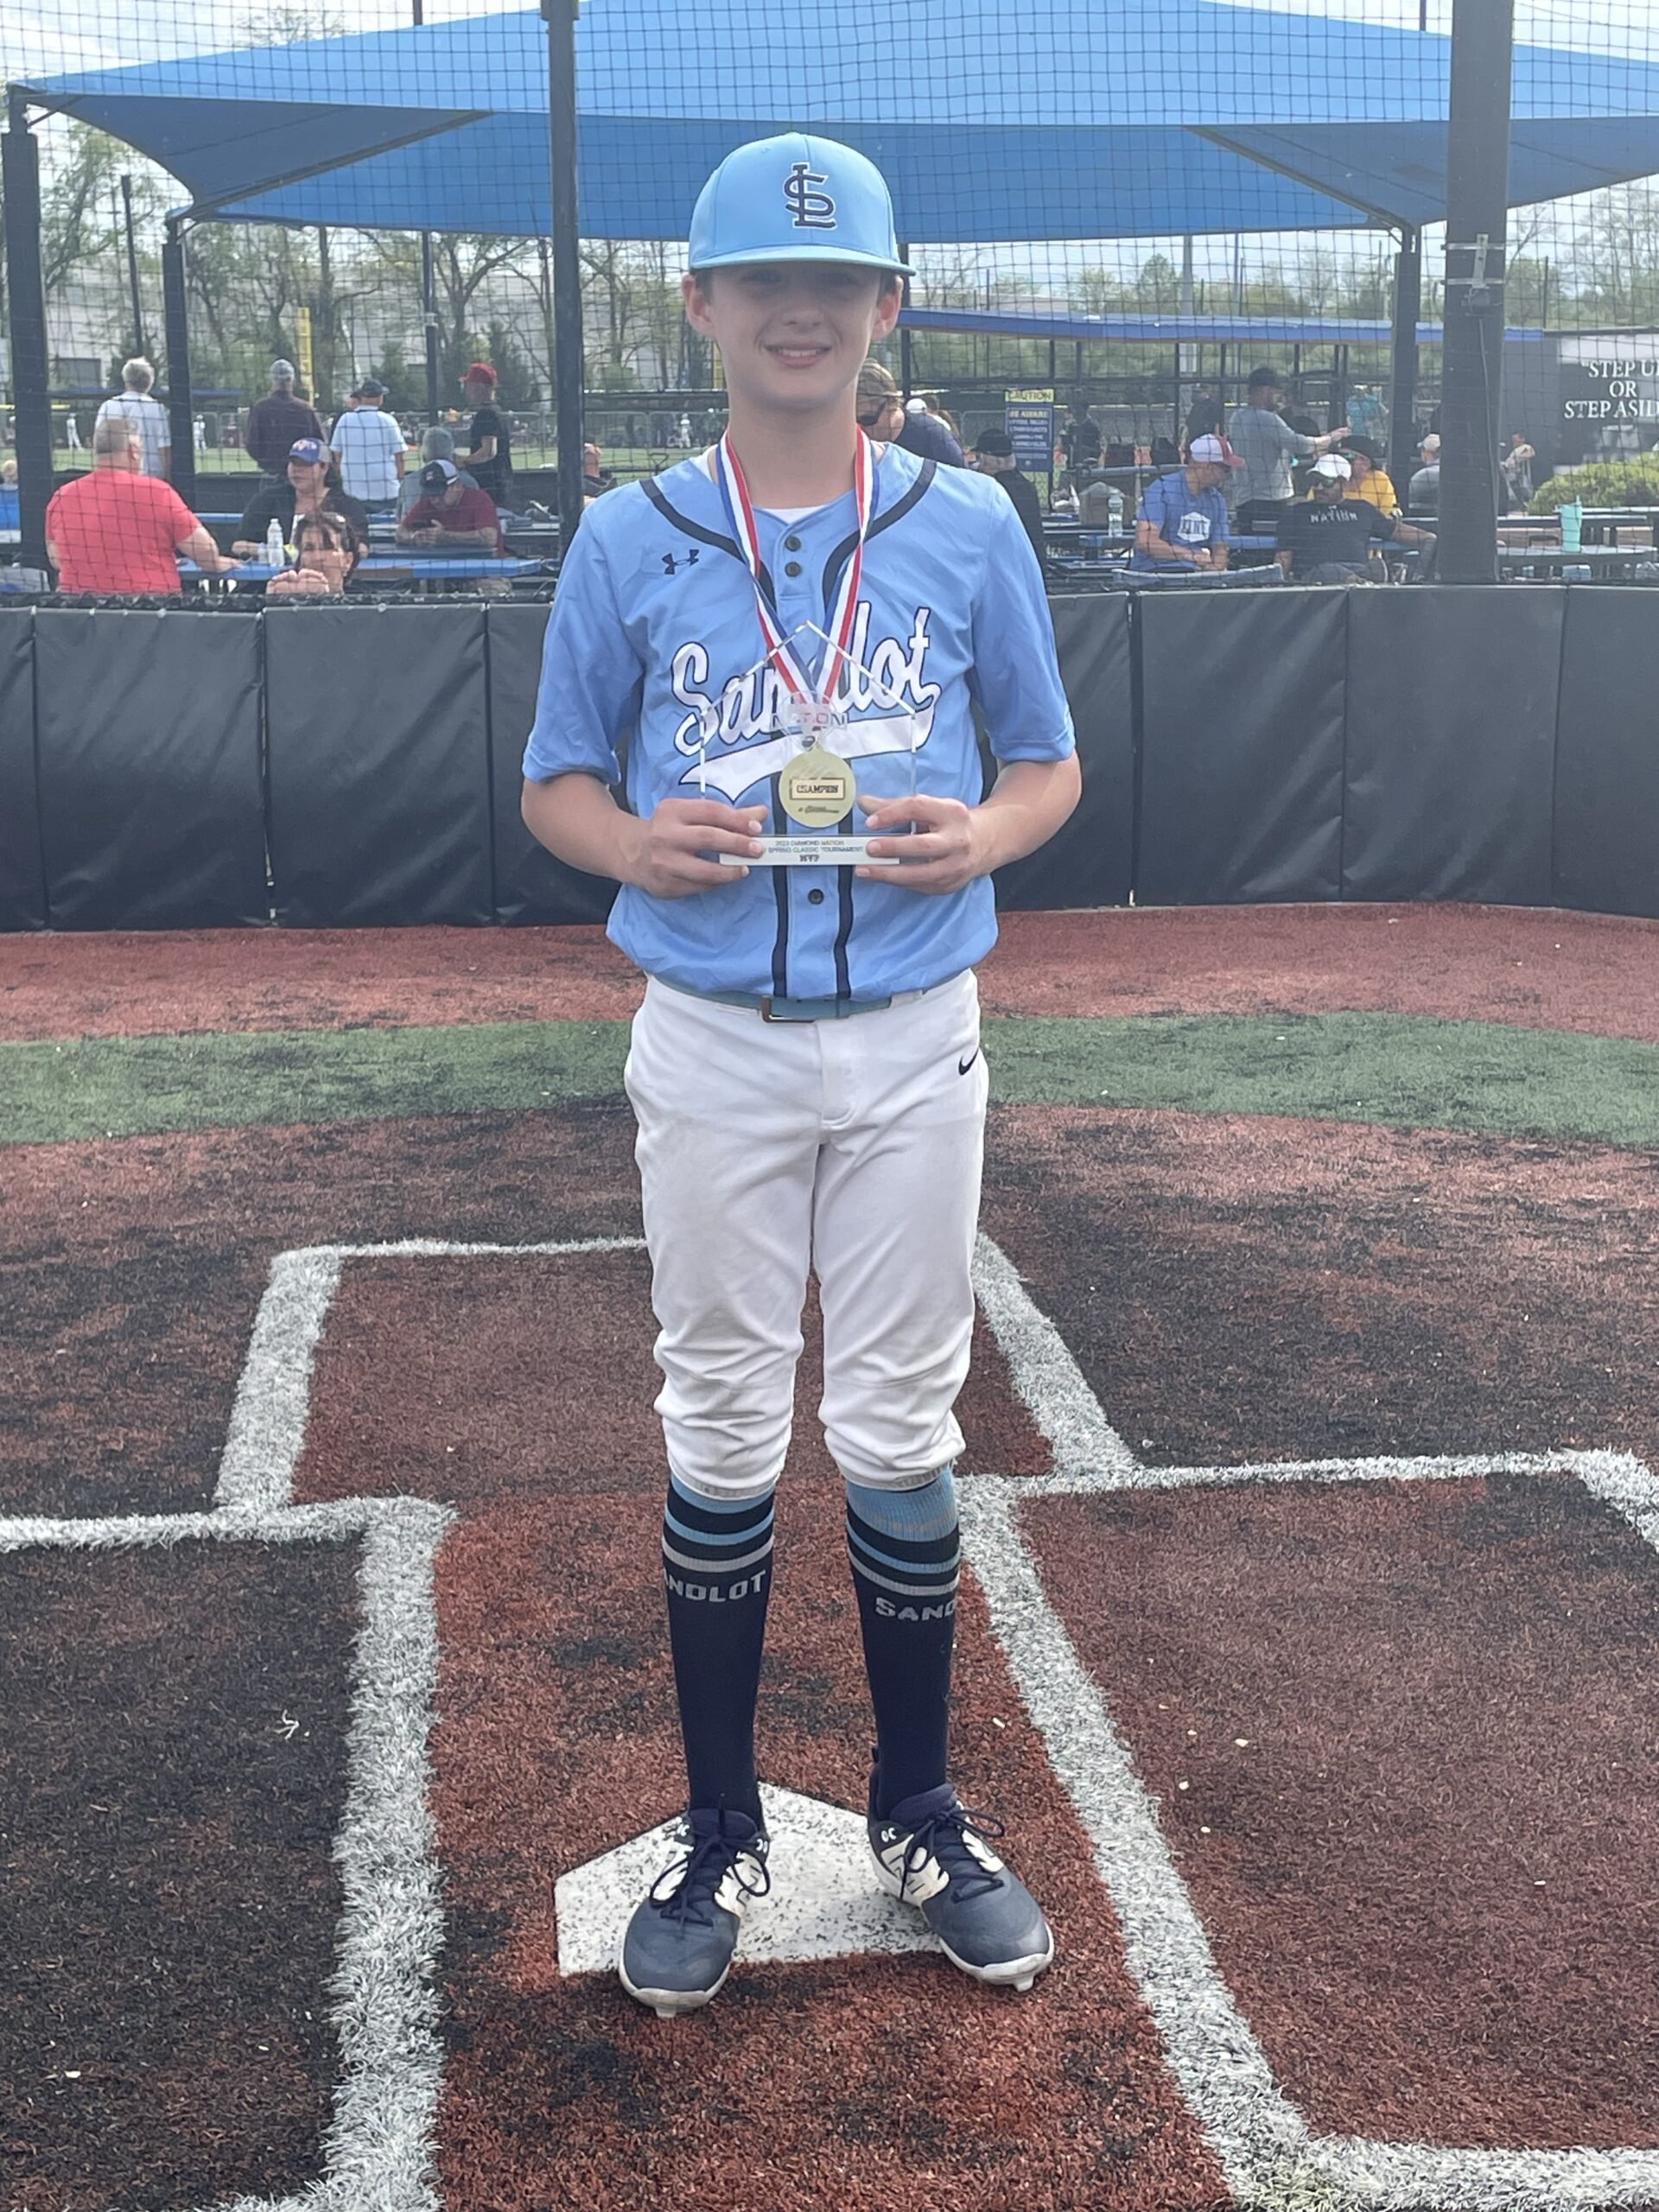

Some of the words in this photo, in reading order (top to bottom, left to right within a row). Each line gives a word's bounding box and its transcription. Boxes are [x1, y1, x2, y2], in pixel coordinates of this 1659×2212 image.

[1009, 390, 1052, 401] CAUTION
[1609, 380, 1637, 397] OR
[1564, 400, 1611, 419] STEP
[1310, 509, 1358, 524] NATION
[671, 601, 941, 757] Sanlot
[796, 785, 839, 793] CHAMPION
